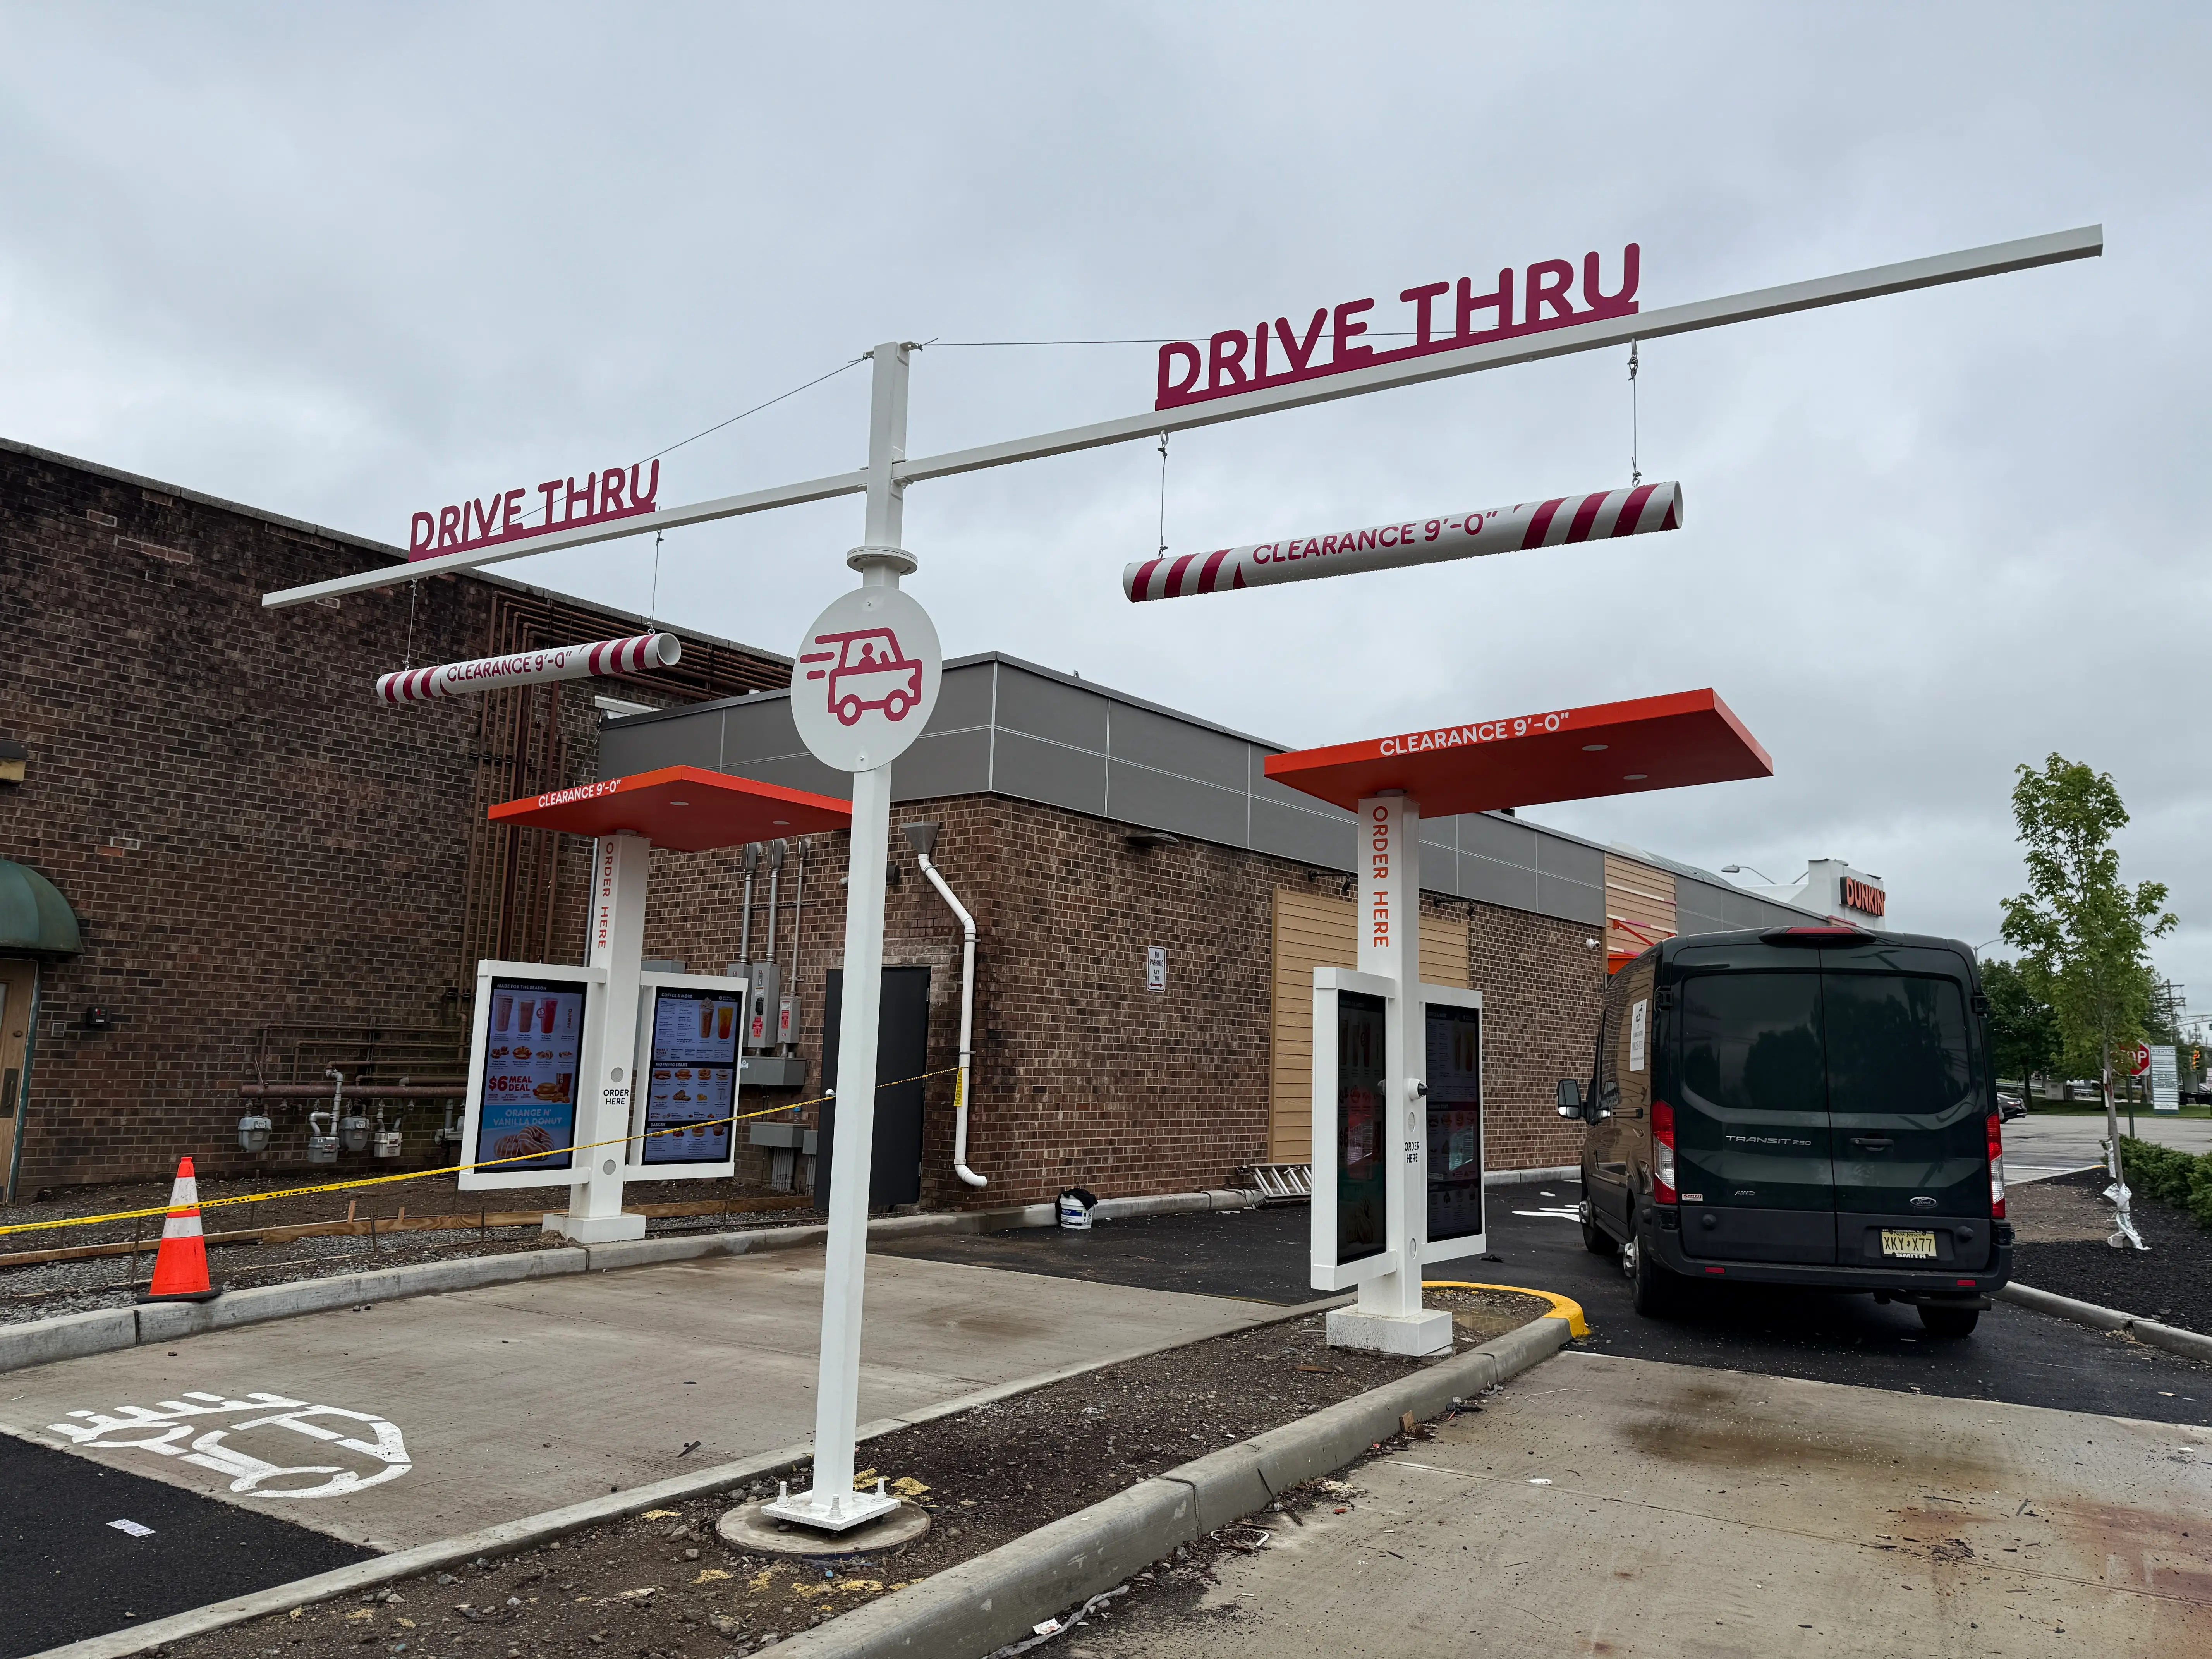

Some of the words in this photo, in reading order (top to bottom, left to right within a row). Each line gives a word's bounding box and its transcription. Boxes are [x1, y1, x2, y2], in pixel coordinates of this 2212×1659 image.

[1156, 297, 1375, 405] DRIVE
[1400, 242, 1640, 349] THRU
[410, 488, 526, 556] DRIVE
[538, 459, 660, 526] THRU
[1253, 523, 1417, 565] CLEARANCE
[447, 656, 532, 682] CLEARANCE
[1380, 721, 1508, 756] CLEARANCE
[539, 785, 595, 807] CLEARANCE
[1373, 806, 1389, 879] ORDER
[603, 842, 614, 897] ORDER
[1846, 876, 1886, 917] DUNKIN'
[598, 906, 609, 949] HERE
[1373, 891, 1389, 948] HERE
[1149, 959, 1164, 967] PARKING
[488, 1075, 508, 1091] $6
[493, 1118, 529, 1126] VANILLA
[1405, 1141, 1419, 1151] ORDER
[1726, 1135, 1791, 1144] TRANSIT
[1407, 1153, 1418, 1163] HERE
[1884, 1237, 1904, 1250] XKY
[1912, 1237, 1932, 1252] X77
